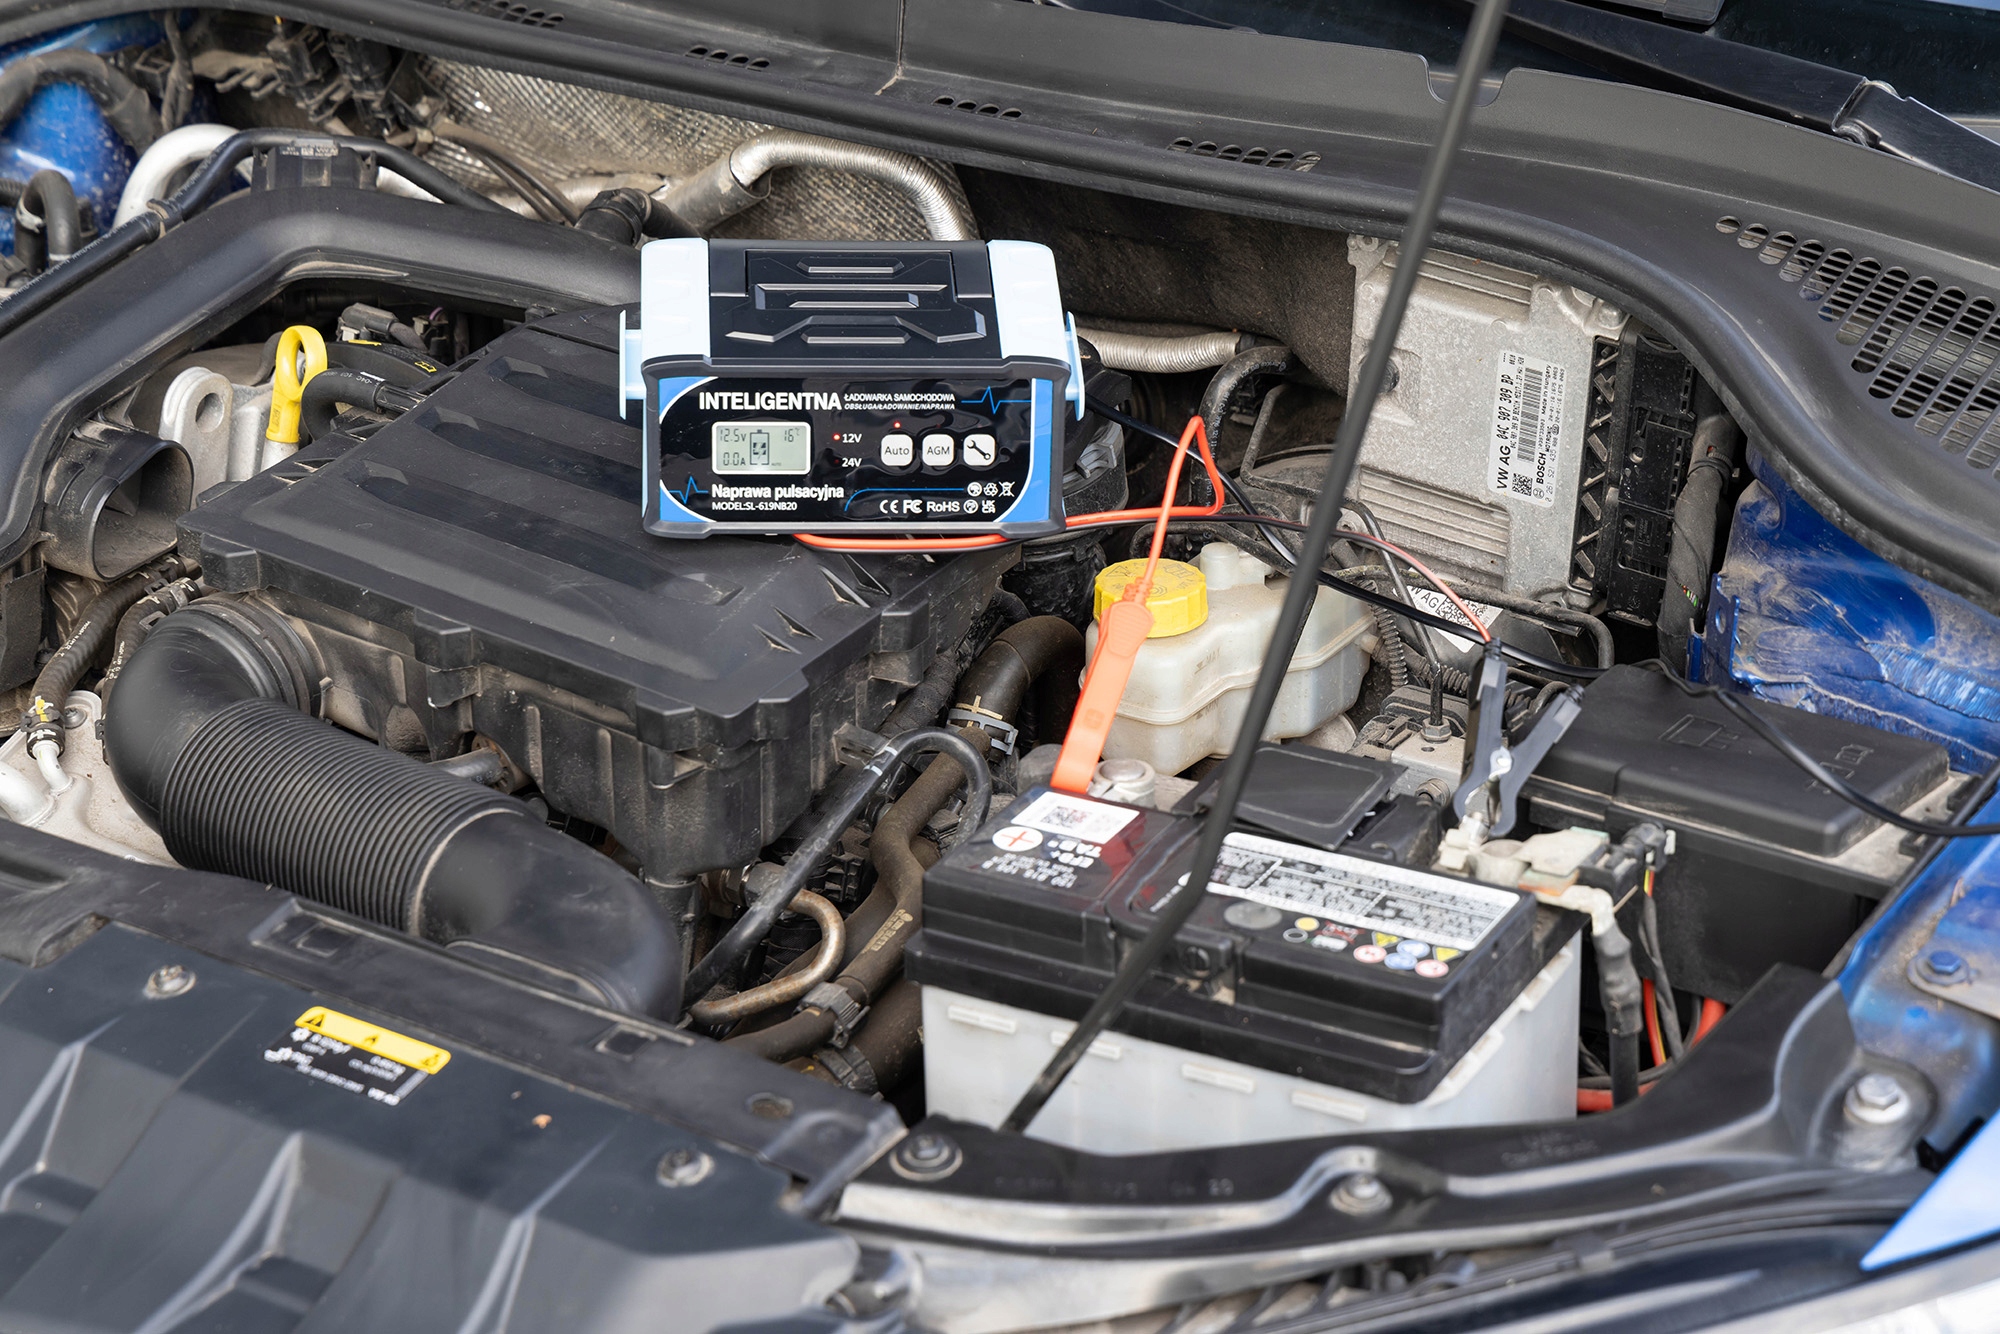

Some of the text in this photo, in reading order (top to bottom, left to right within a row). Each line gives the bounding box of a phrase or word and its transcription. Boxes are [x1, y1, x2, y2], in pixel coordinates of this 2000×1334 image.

[699, 392, 955, 410] INTELIGENTNA ŁADOWARKA SAMOCHODOWA
[842, 434, 862, 443] 12V
[1496, 374, 1513, 490] VW AG 04C 907 309 BP
[884, 446, 910, 456] Auto
[926, 446, 950, 456] AGM
[842, 458, 862, 467] 24V
[1535, 452, 1546, 484] BOSCH
[712, 484, 844, 500] Naprawa pulsacyjna
[926, 502, 960, 512] RoHS
[1420, 592, 1439, 608] AG
